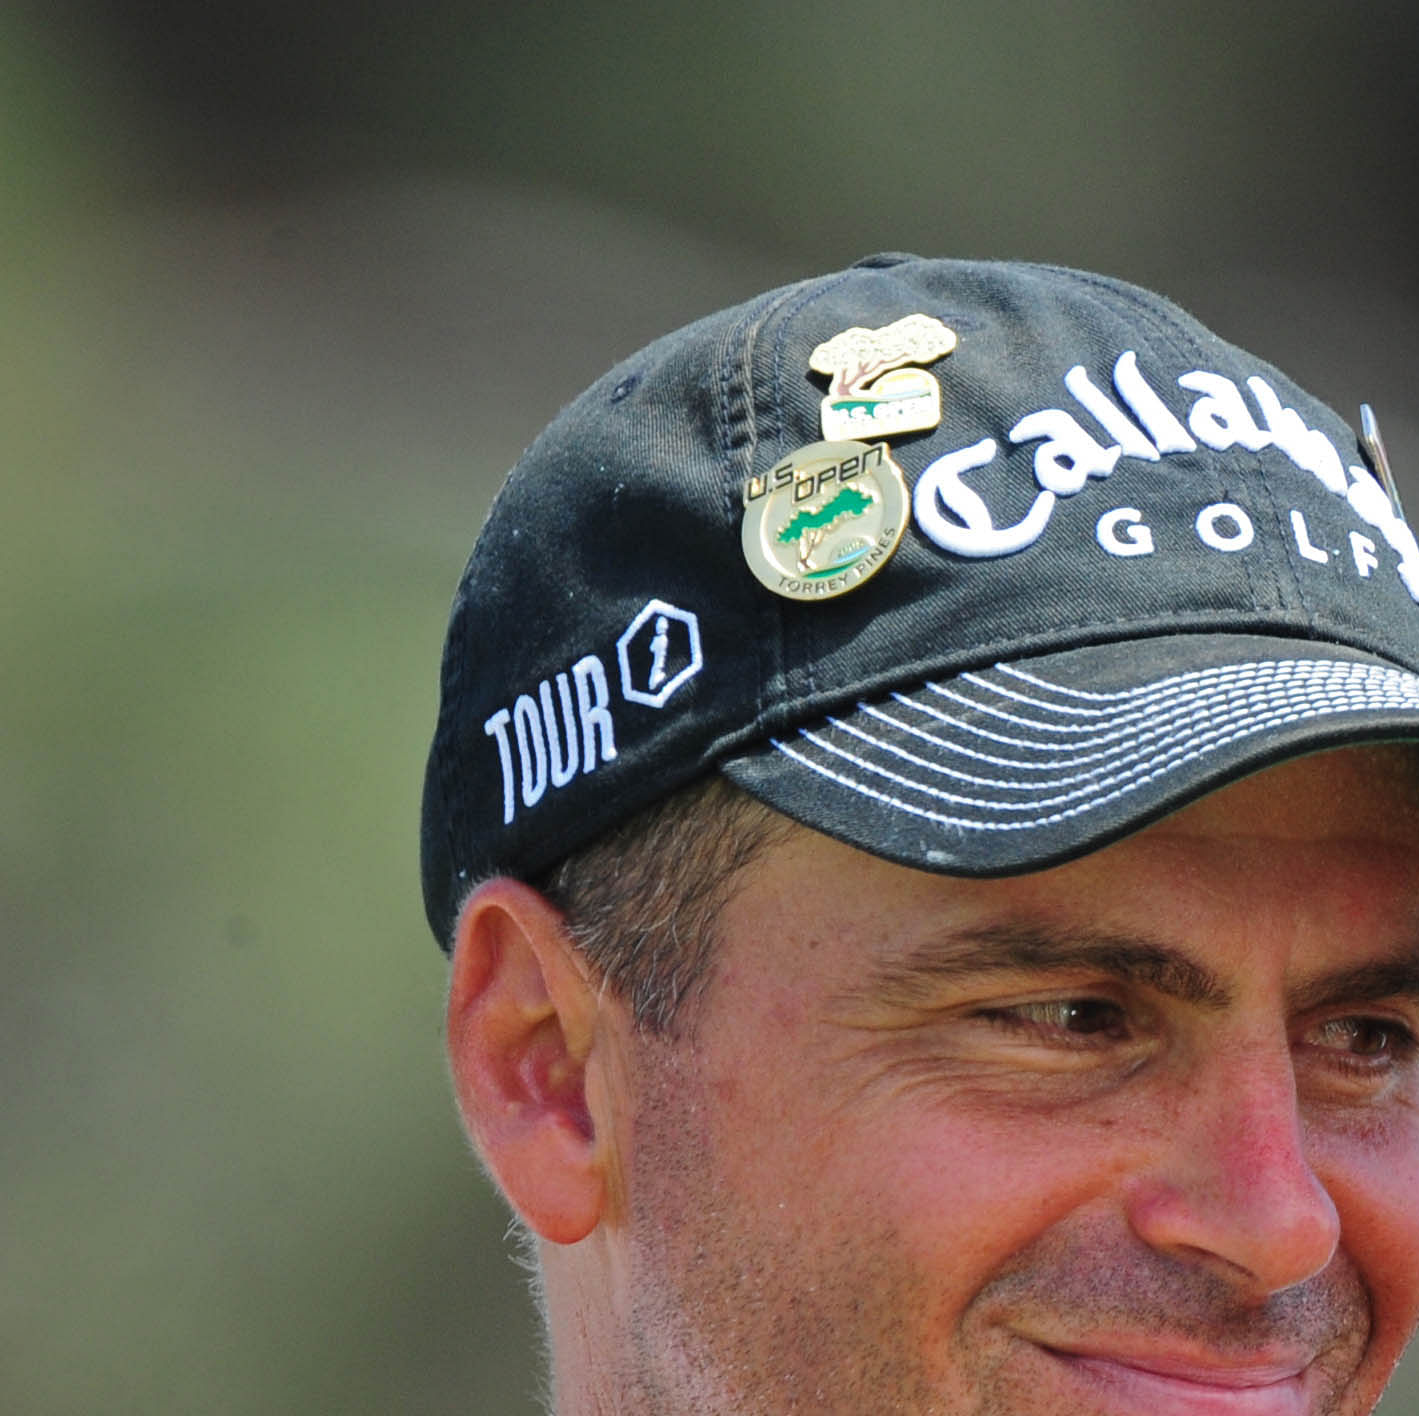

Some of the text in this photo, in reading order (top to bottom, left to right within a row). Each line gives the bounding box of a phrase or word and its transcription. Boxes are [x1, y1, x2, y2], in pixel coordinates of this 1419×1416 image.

[776, 574, 849, 594] TORREY
[856, 527, 896, 577] PINES
[1096, 501, 1379, 577] GOLF
[484, 654, 618, 825] TOUR
